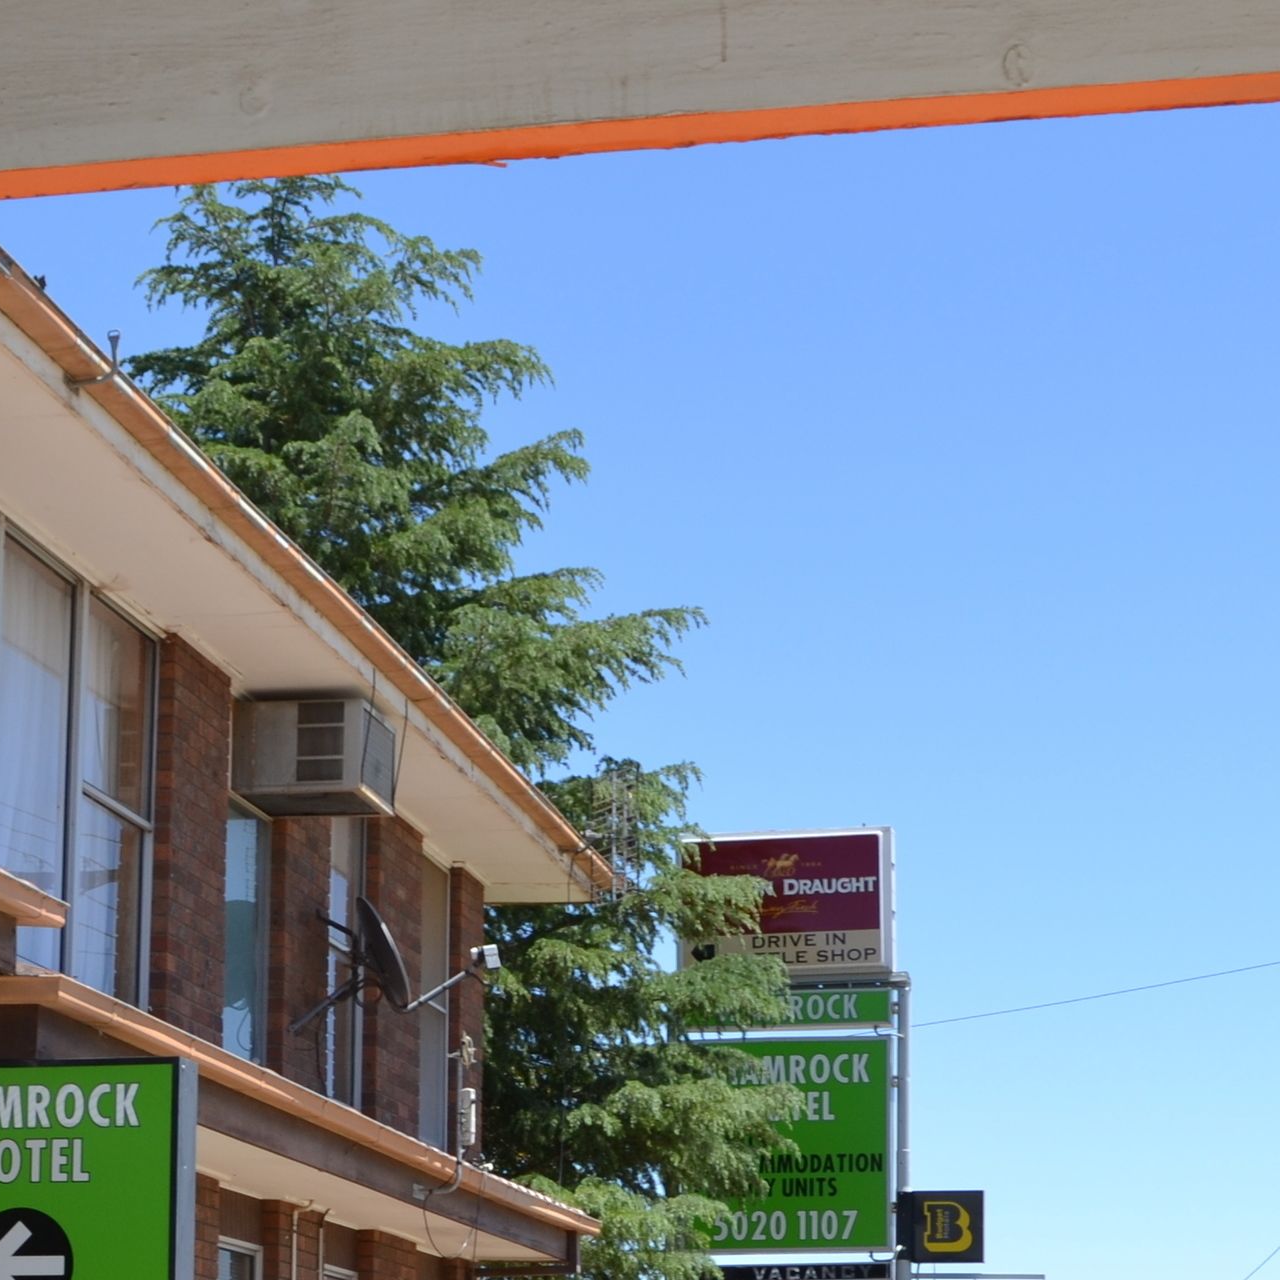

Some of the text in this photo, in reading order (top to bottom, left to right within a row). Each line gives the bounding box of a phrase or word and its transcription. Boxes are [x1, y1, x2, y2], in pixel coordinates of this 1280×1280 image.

[783, 876, 877, 896] DRAUGHT
[752, 932, 846, 949] DRIVE IN
[817, 947, 877, 963] SHOP
[782, 1177, 838, 1197] UNITS
[713, 1209, 858, 1241] 5020 1107
[923, 1201, 973, 1252] B
[753, 1265, 872, 1280] VACANCY
